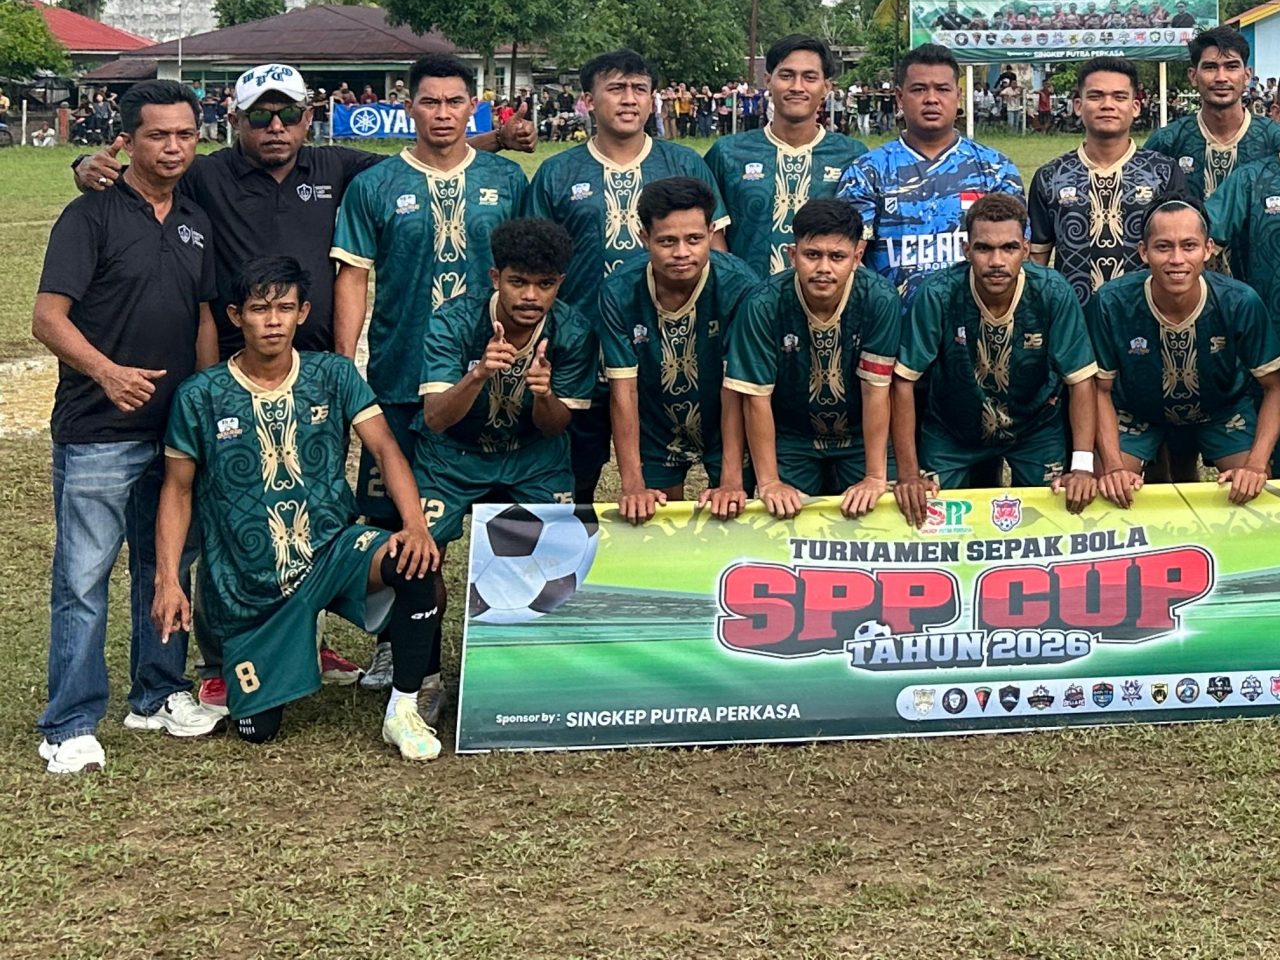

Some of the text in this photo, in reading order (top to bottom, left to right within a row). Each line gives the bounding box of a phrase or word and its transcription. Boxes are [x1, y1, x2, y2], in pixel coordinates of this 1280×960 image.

[790, 526, 1149, 562] TURNAMEN SEPAK BOLA
[721, 548, 1210, 648] SPP CUP
[847, 632, 1091, 666] TAHUN 2026
[235, 660, 259, 694] 8
[495, 713, 540, 727] Sponsor
[565, 709, 647, 729] SINGKEP
[650, 706, 711, 725] PUTRA
[716, 703, 801, 722] PERKASA
